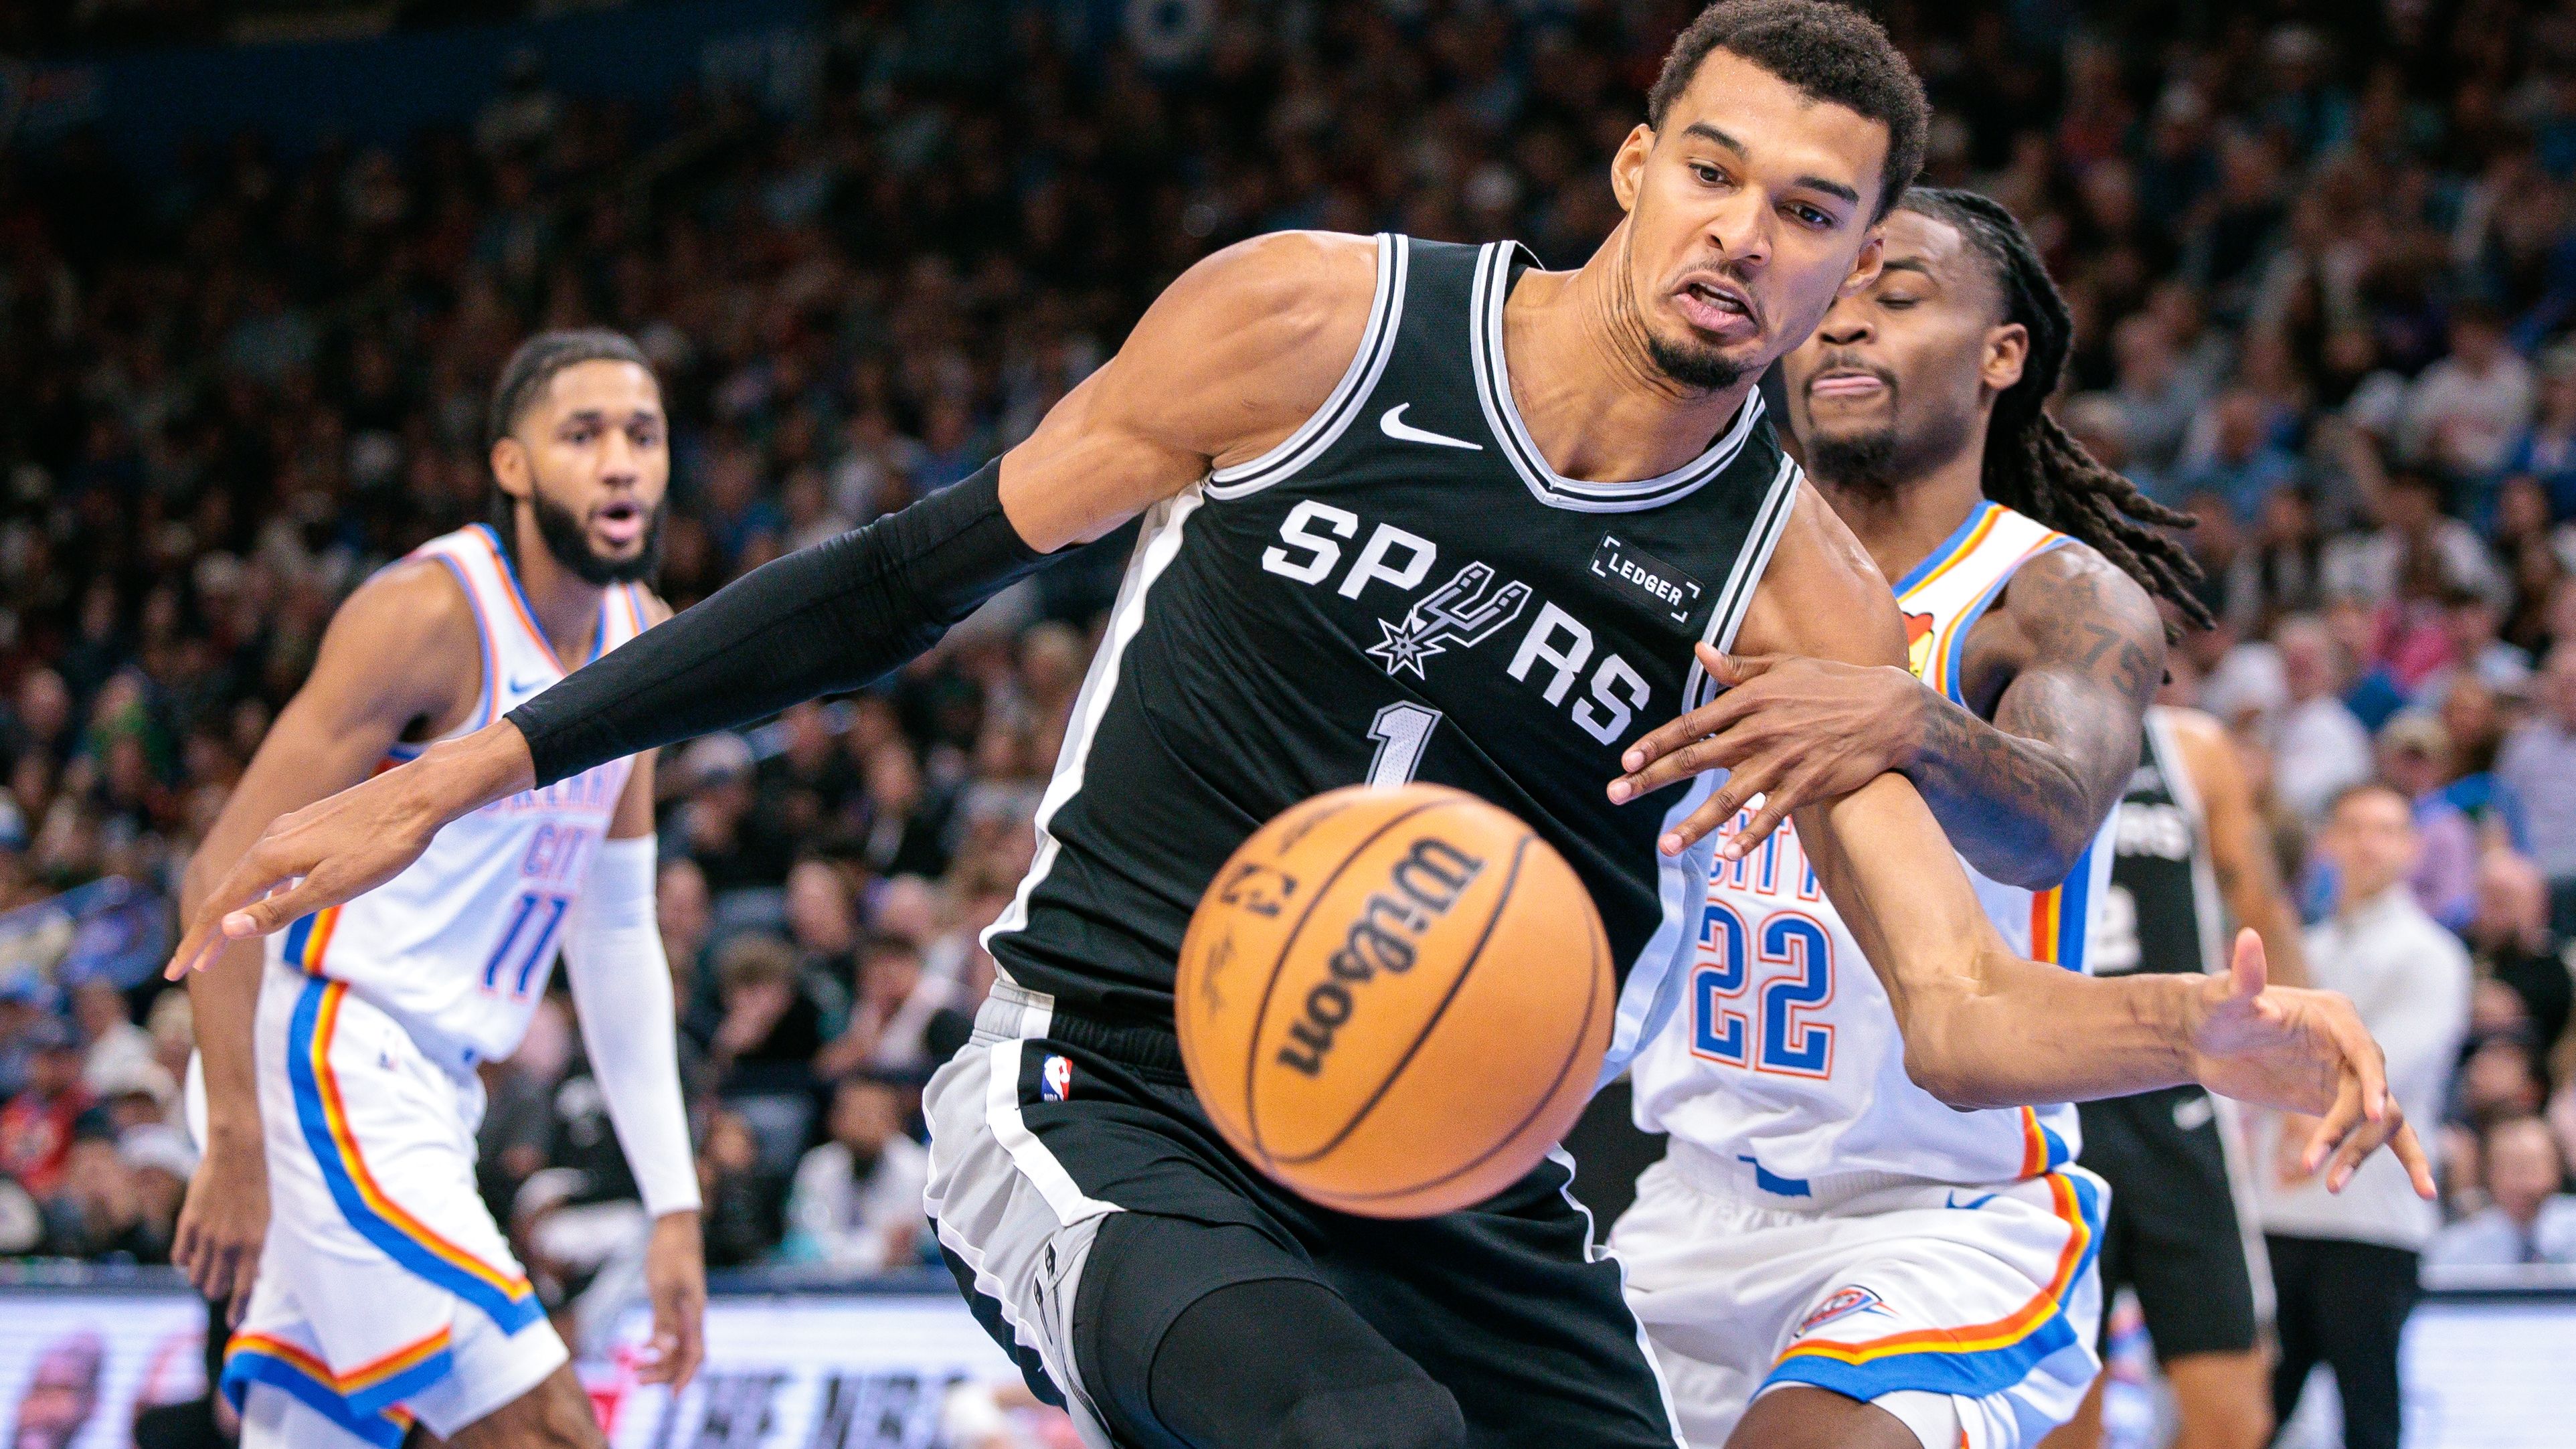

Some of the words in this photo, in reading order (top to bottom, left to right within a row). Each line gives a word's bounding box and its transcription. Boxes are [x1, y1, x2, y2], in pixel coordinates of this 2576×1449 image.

[1262, 499, 1651, 746] SPURS
[1608, 552, 1683, 606] LEDGER
[1364, 700, 1443, 791] 1
[478, 889, 577, 1004] 11
[1275, 835, 1487, 1079] Wilson
[1689, 897, 1836, 1081] 22
